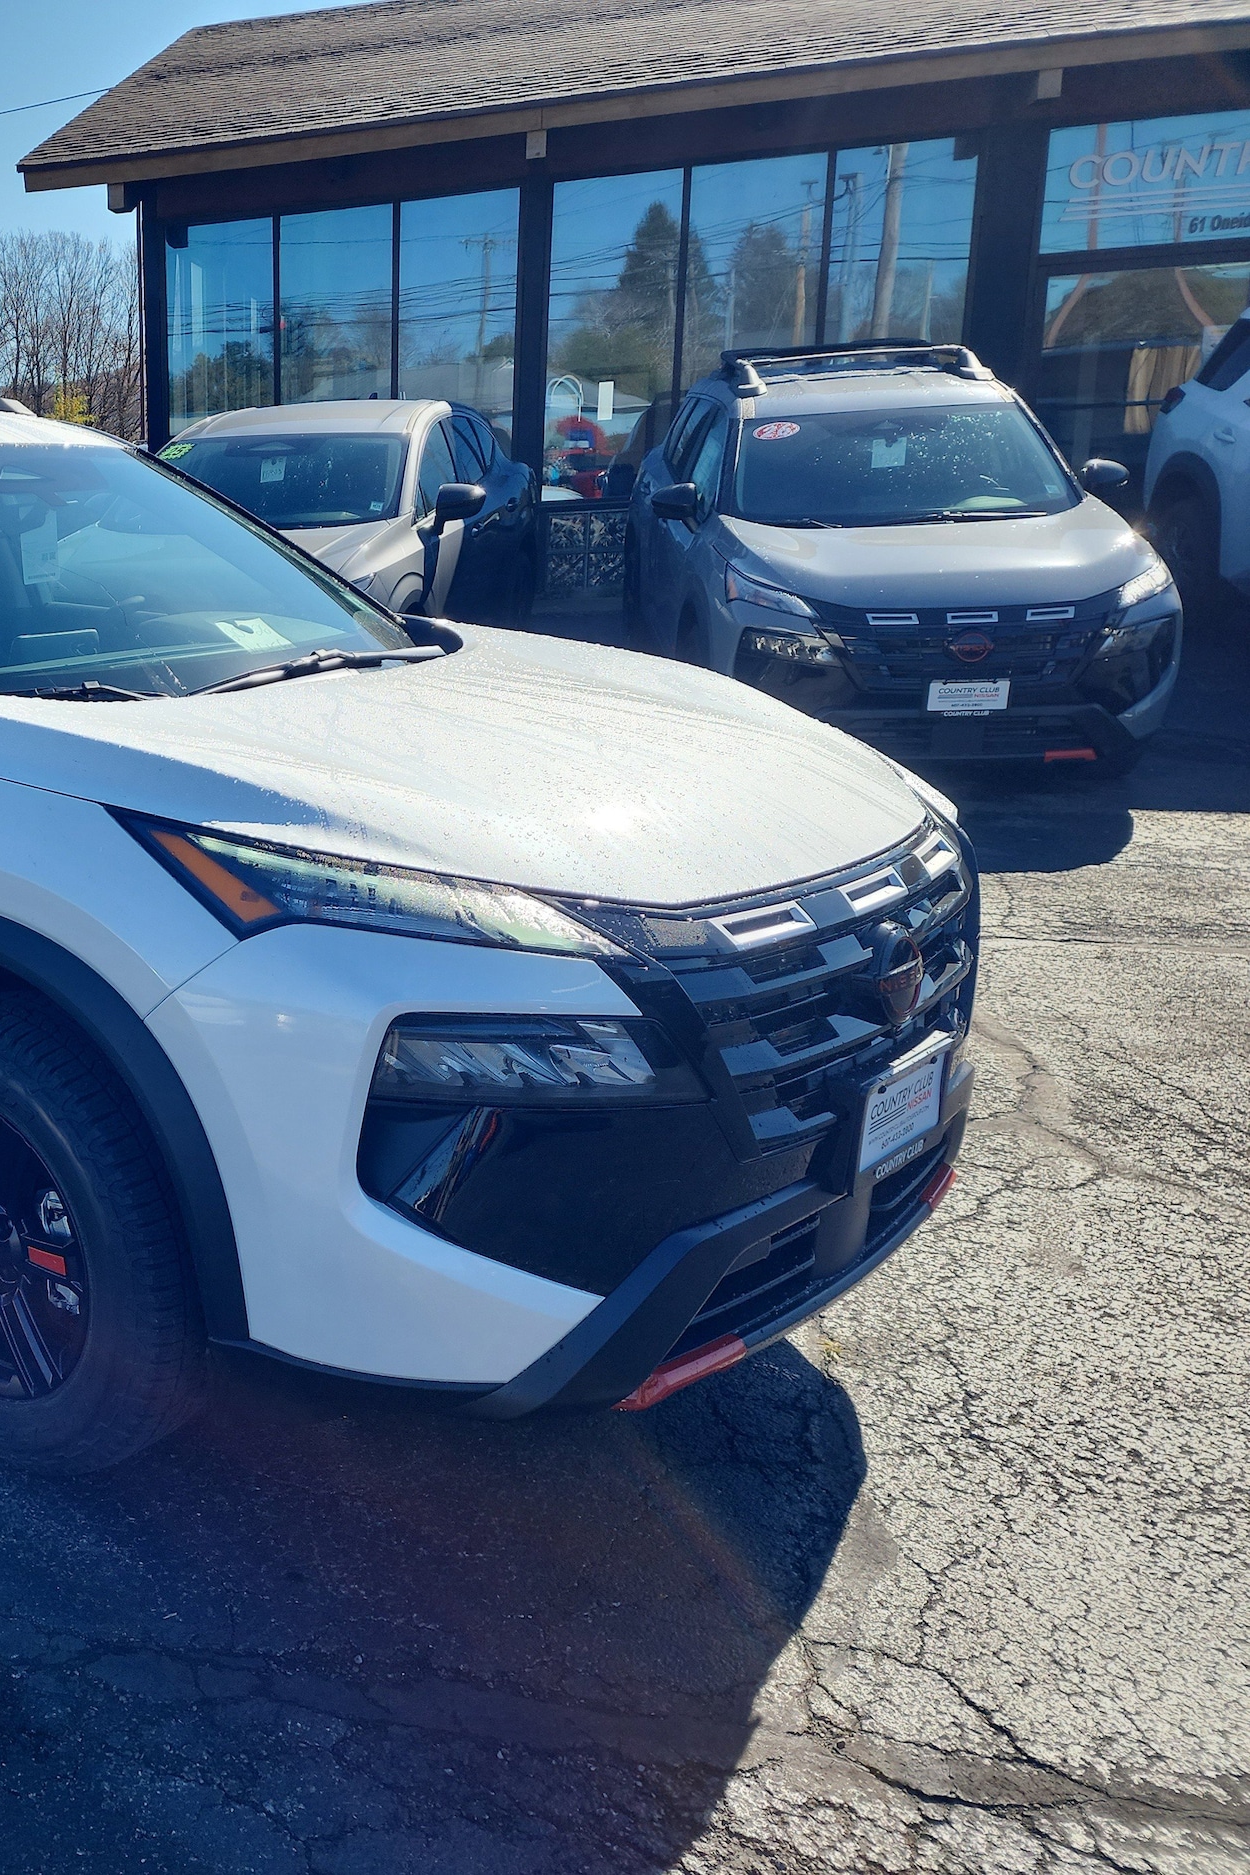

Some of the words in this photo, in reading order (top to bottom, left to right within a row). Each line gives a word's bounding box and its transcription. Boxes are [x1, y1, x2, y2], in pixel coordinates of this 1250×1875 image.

[1188, 216, 1207, 234] 61
[870, 1083, 914, 1120] COUNTRY
[914, 1071, 934, 1094] CLUB
[907, 1088, 932, 1111] NISSAN
[875, 1149, 907, 1179] COUNTRY
[907, 1139, 924, 1161] CLUB
